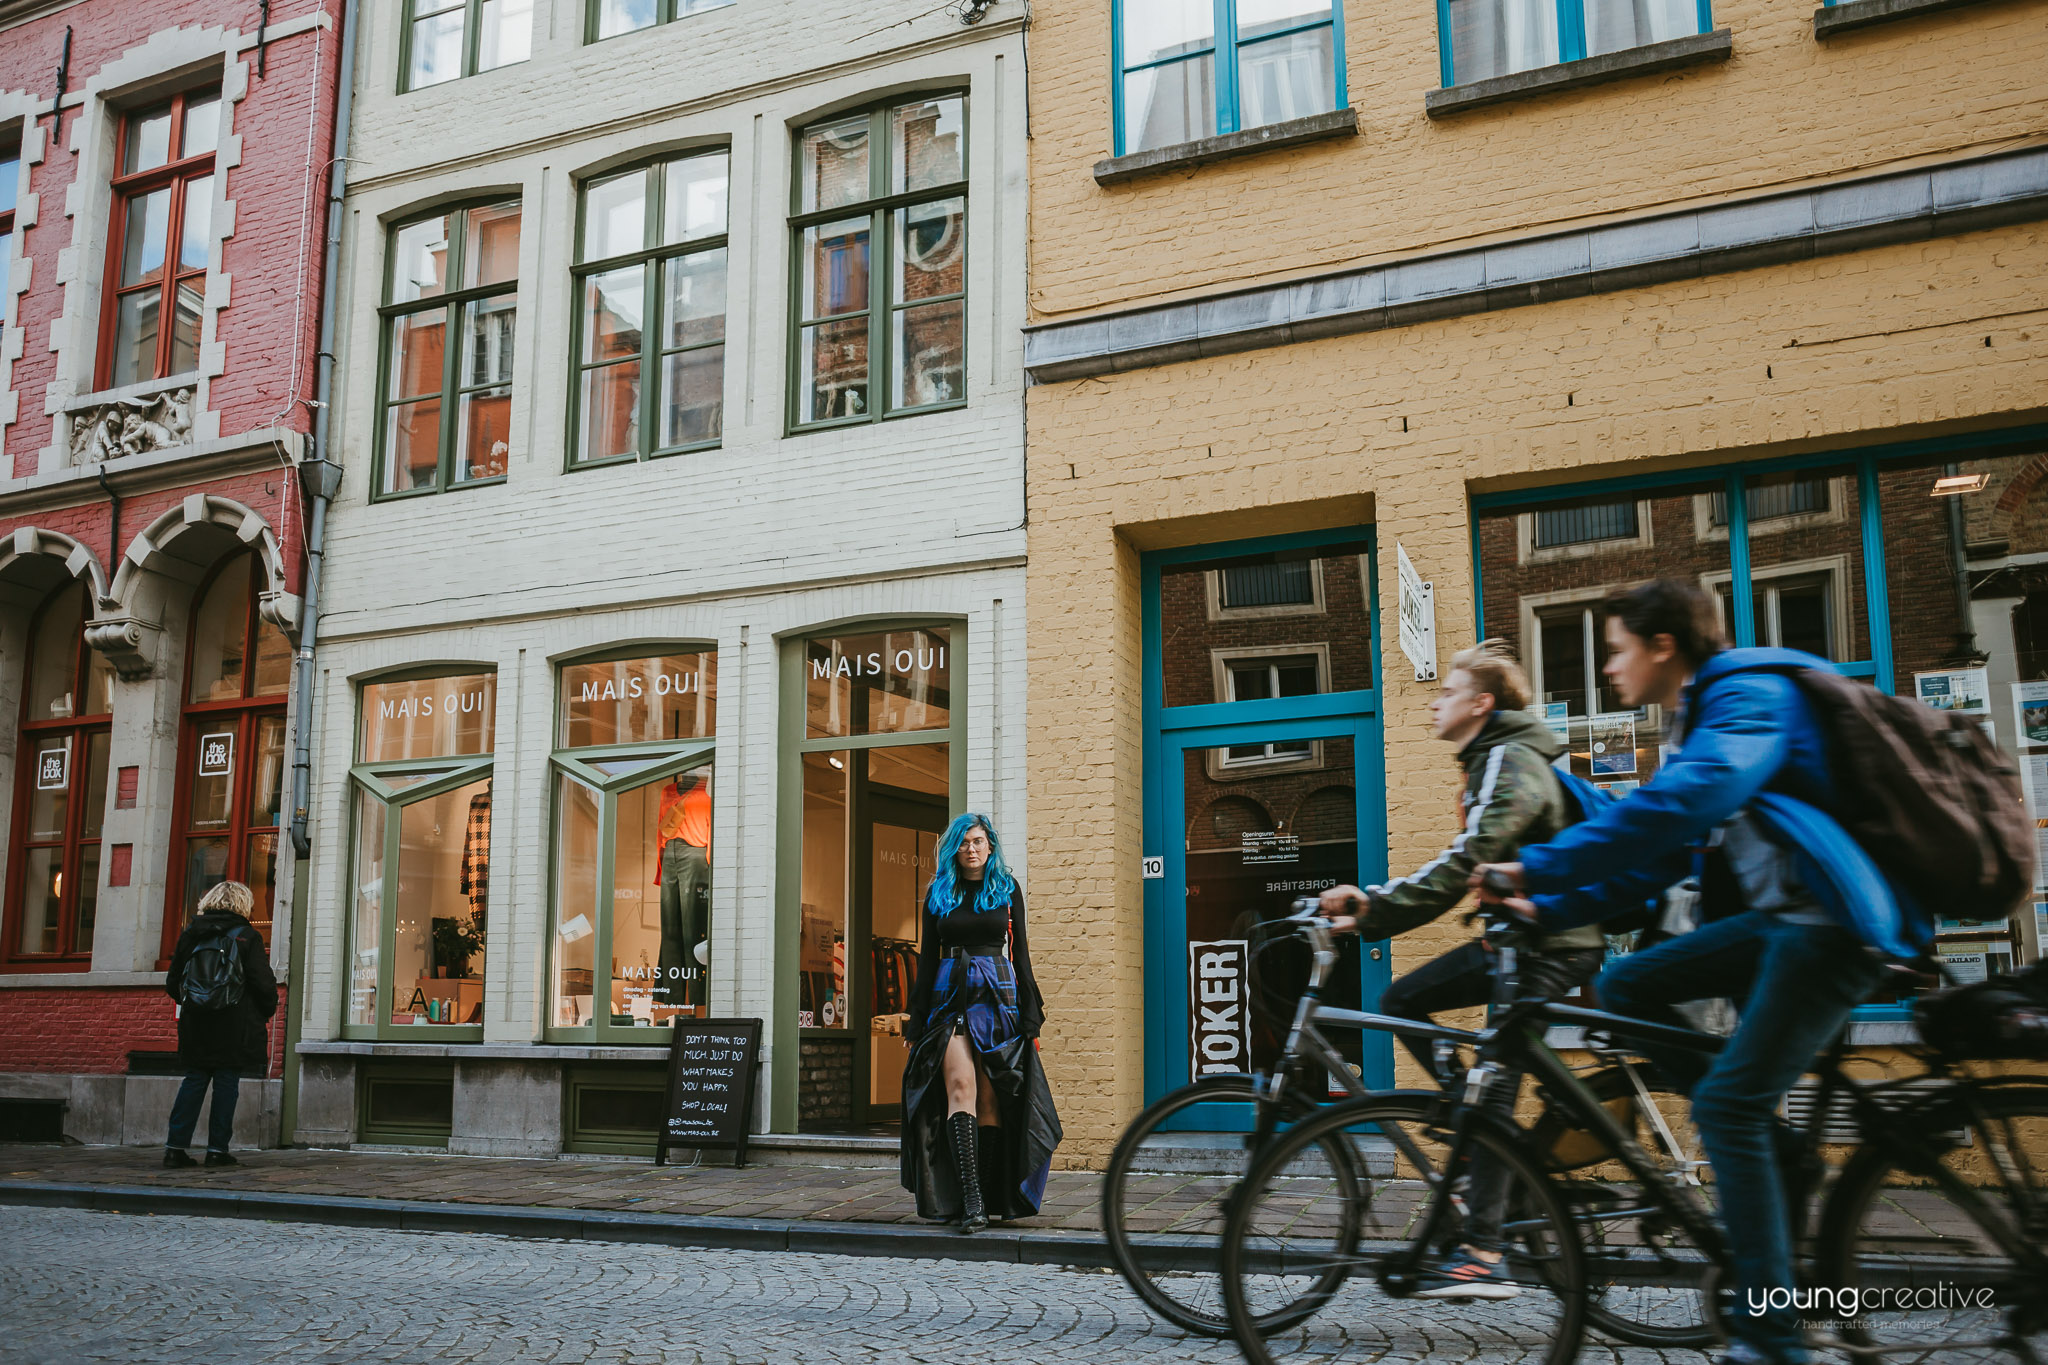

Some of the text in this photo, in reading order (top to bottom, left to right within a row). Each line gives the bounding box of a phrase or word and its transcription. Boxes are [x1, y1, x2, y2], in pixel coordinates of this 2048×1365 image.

[813, 646, 944, 680] MAIS OUI
[582, 671, 698, 702] MAIS OUI
[380, 691, 483, 720] MAIS OUI
[209, 741, 225, 754] the
[46, 757, 61, 768] the
[205, 751, 227, 765] box
[42, 765, 62, 779] box
[880, 849, 930, 868] MAIS OUI
[1143, 860, 1161, 874] 10
[622, 966, 697, 980] MAIS OUI
[647, 986, 671, 994] zaterdag
[407, 987, 429, 1012] A
[685, 1035, 747, 1045] DON'T THINK TOO
[709, 1049, 731, 1061] JUST
[732, 1051, 743, 1061] DO
[682, 1067, 734, 1077] WHAT MAKES
[682, 1081, 699, 1091] YOU
[681, 1100, 728, 1113] SHOP LOCAL!
